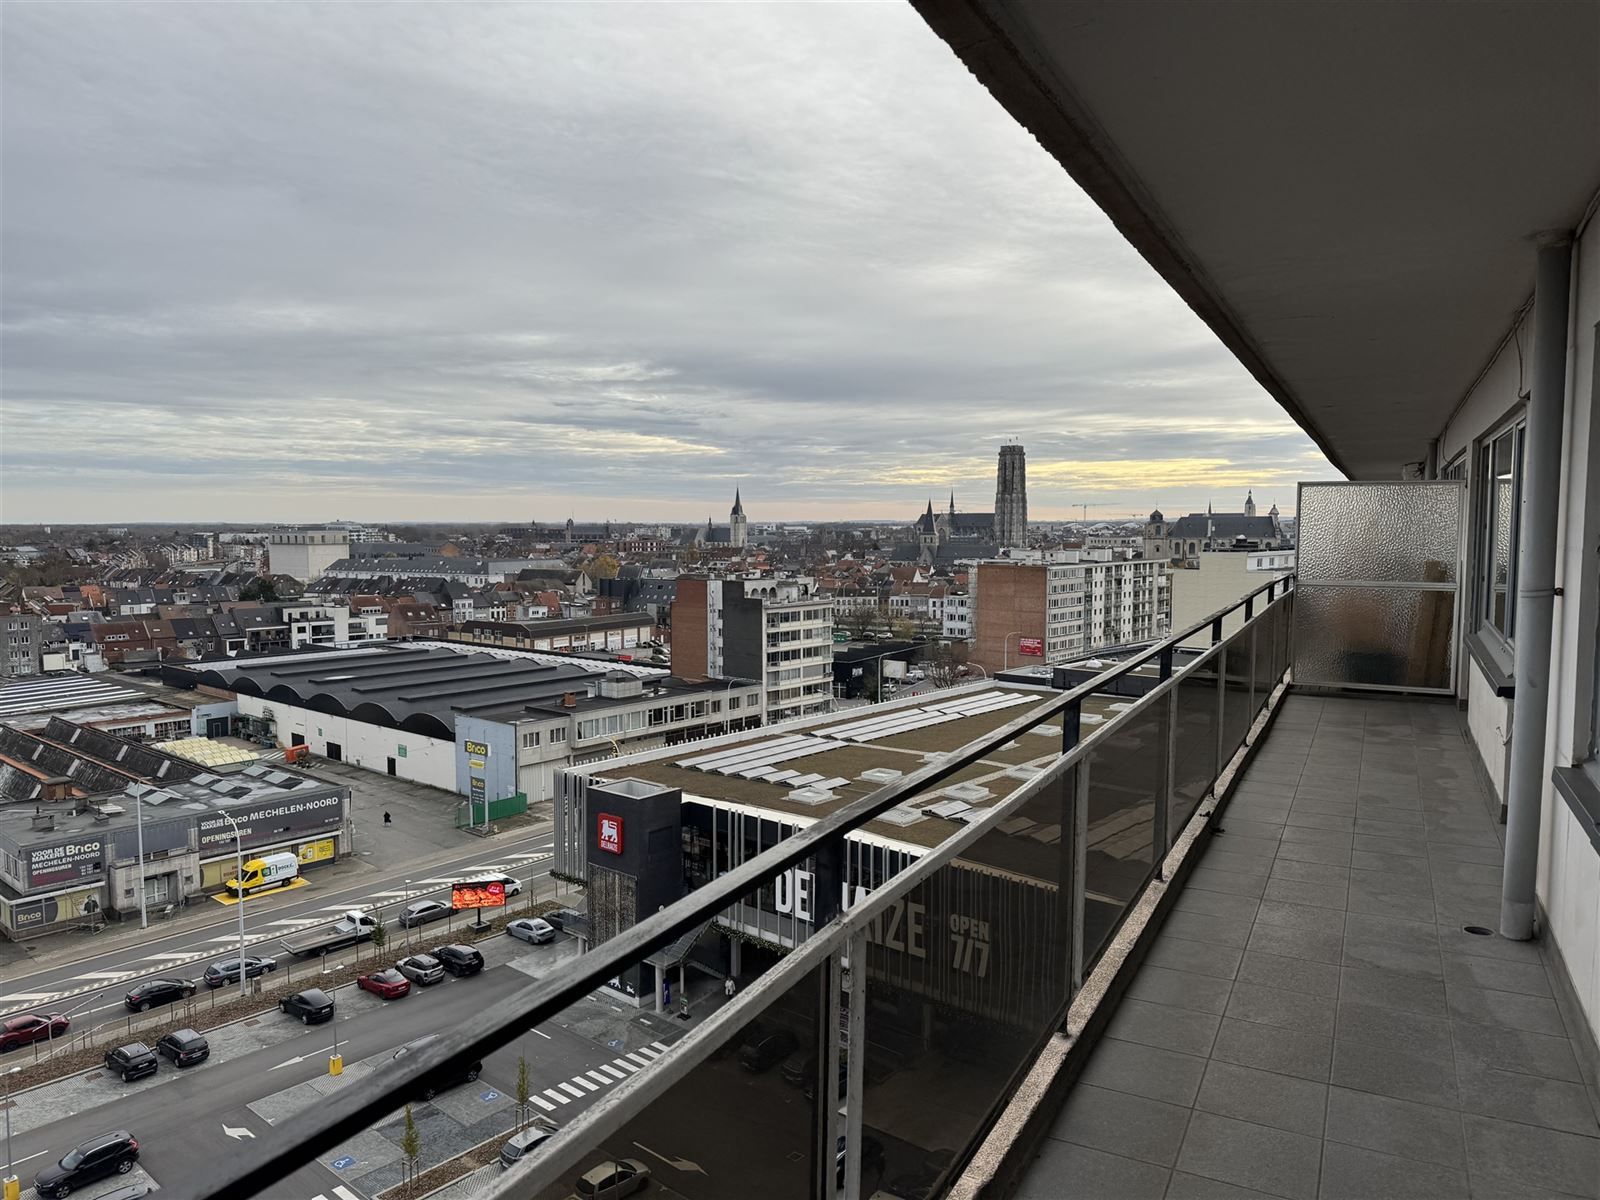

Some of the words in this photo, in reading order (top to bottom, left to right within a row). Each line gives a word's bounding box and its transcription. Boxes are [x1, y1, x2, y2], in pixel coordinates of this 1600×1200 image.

[466, 741, 486, 755] Brico
[250, 797, 339, 821] MECHELEN-NOORD
[66, 842, 100, 855] Brico
[31, 851, 100, 870] MECHELEN-NOORD
[950, 913, 989, 941] OPEN
[950, 933, 989, 978] 7/7
